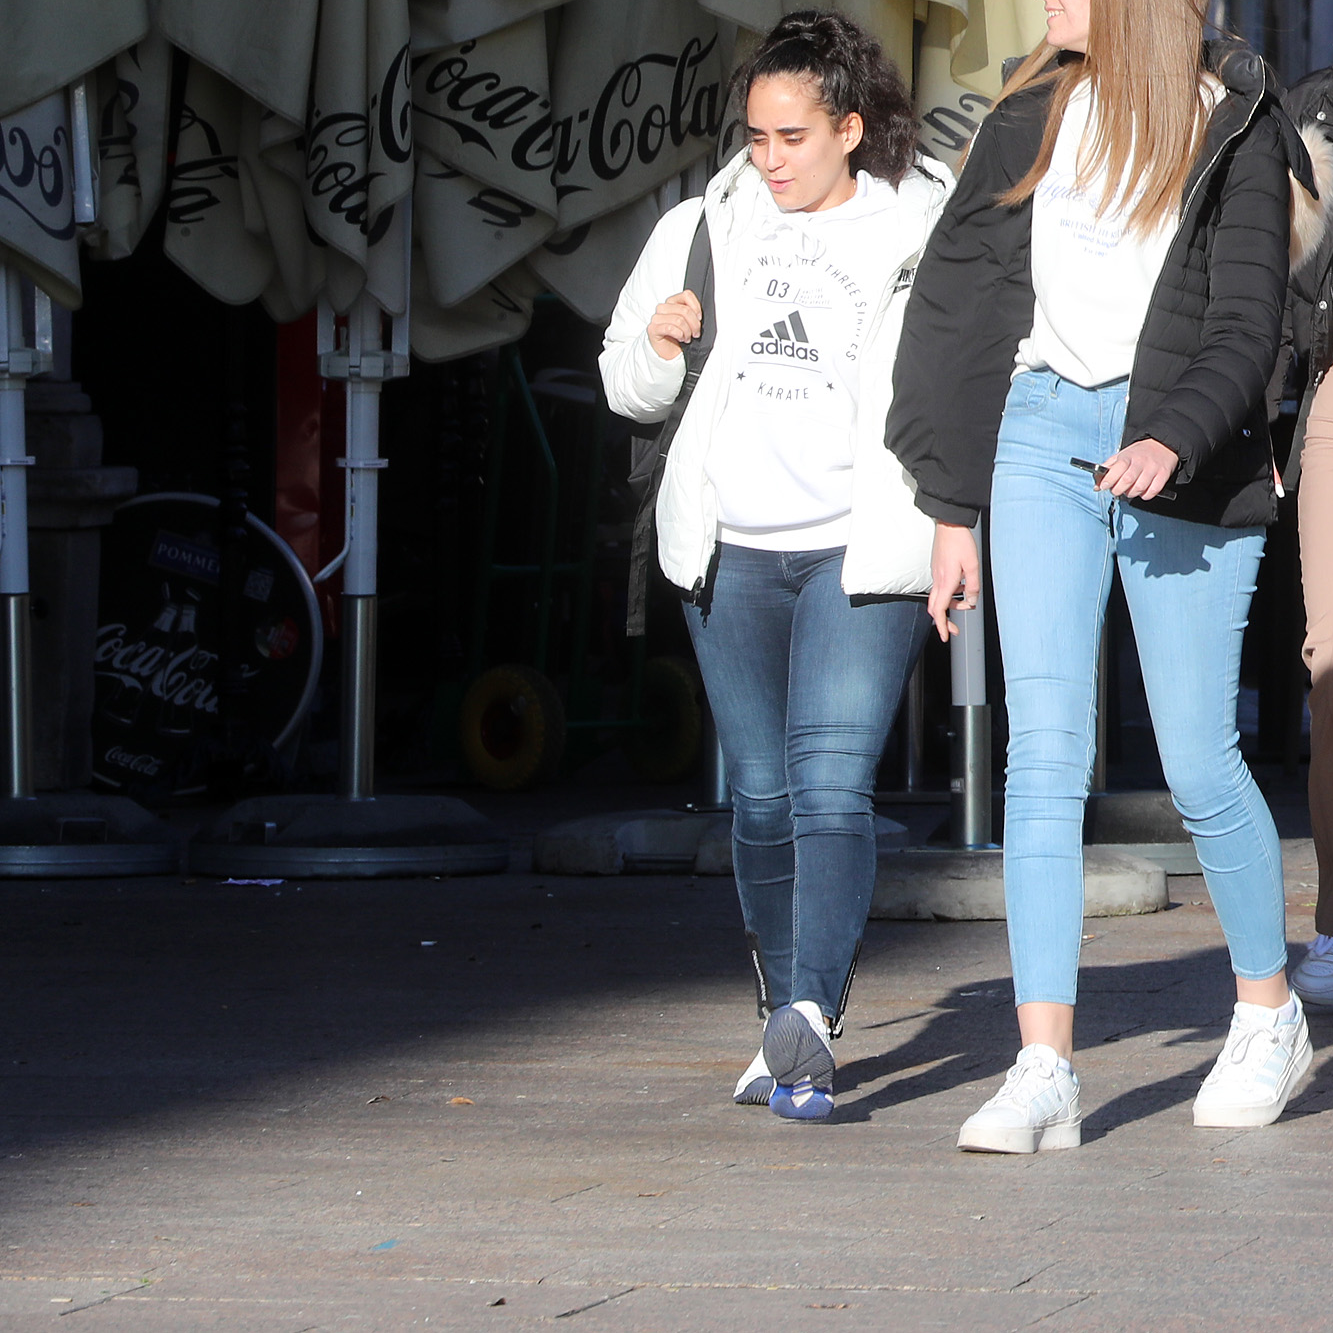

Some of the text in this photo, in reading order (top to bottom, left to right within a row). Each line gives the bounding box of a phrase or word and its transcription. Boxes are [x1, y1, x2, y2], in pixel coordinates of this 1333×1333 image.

[766, 278, 790, 299] 03
[825, 263, 862, 297] THREE
[750, 338, 819, 363] adidas
[757, 381, 810, 401] KARATE
[156, 542, 221, 575] POMME
